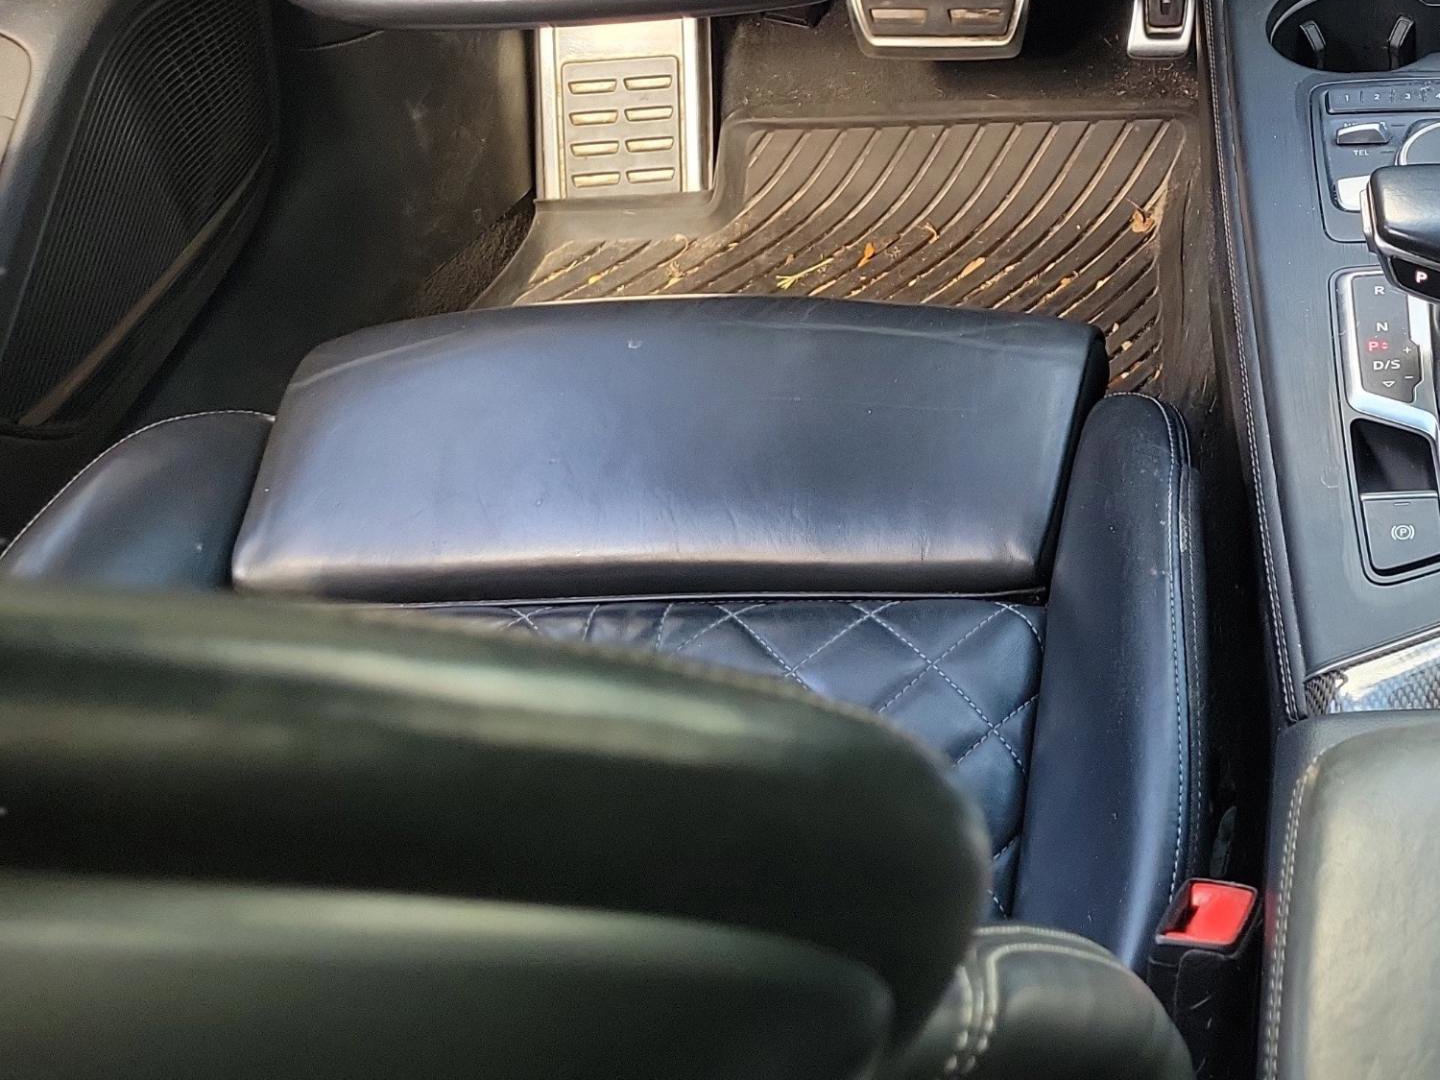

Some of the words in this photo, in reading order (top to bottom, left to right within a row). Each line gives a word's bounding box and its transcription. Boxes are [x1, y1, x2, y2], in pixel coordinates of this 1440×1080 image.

[1353, 149, 1369, 157] TEL
[1415, 271, 1428, 283] P
[1374, 286, 1386, 296] R
[1376, 322, 1388, 332] N
[1373, 360, 1401, 371] D/S
